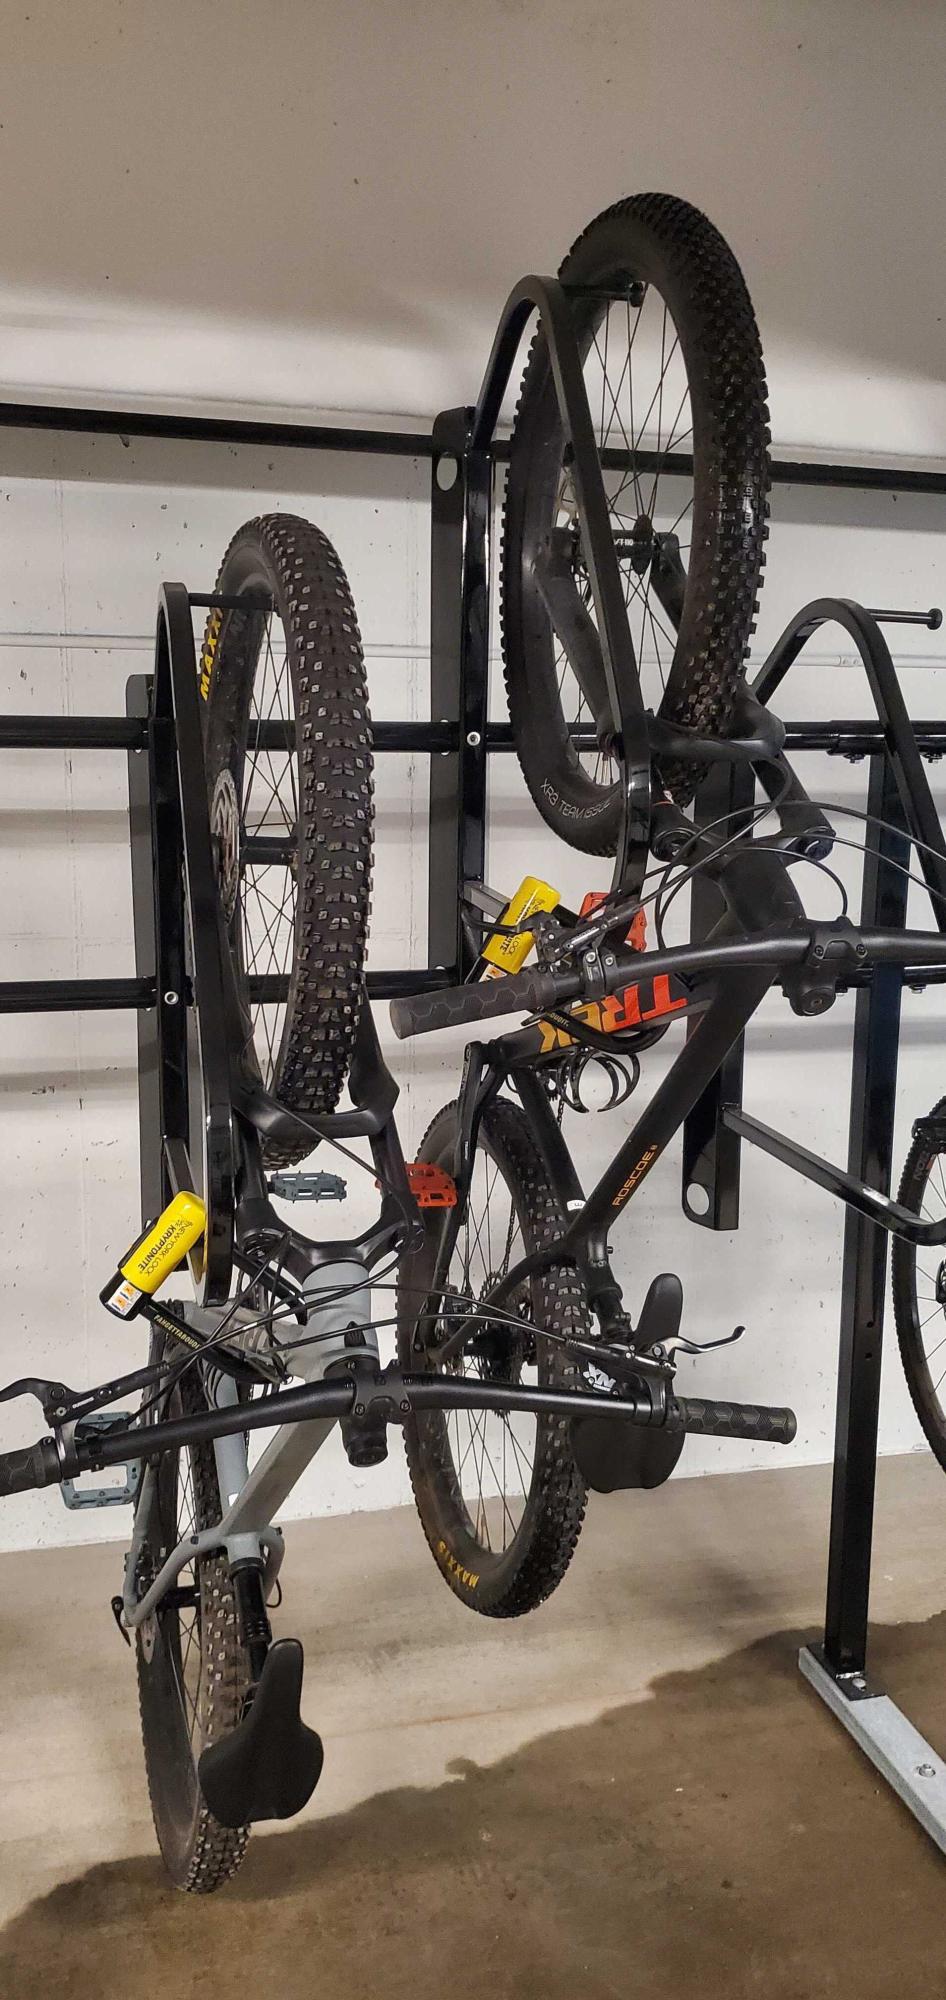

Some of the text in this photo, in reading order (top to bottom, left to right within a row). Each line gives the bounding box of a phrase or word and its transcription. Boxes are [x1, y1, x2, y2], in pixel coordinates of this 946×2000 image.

[540, 778, 559, 806] XR3
[559, 800, 585, 819] TEAM
[537, 974, 688, 1054] TREK
[612, 1151, 655, 1206] ROSCOE
[138, 1224, 176, 1271] KRYPTONITE
[153, 1314, 201, 1349] FAHGETTABOUDI
